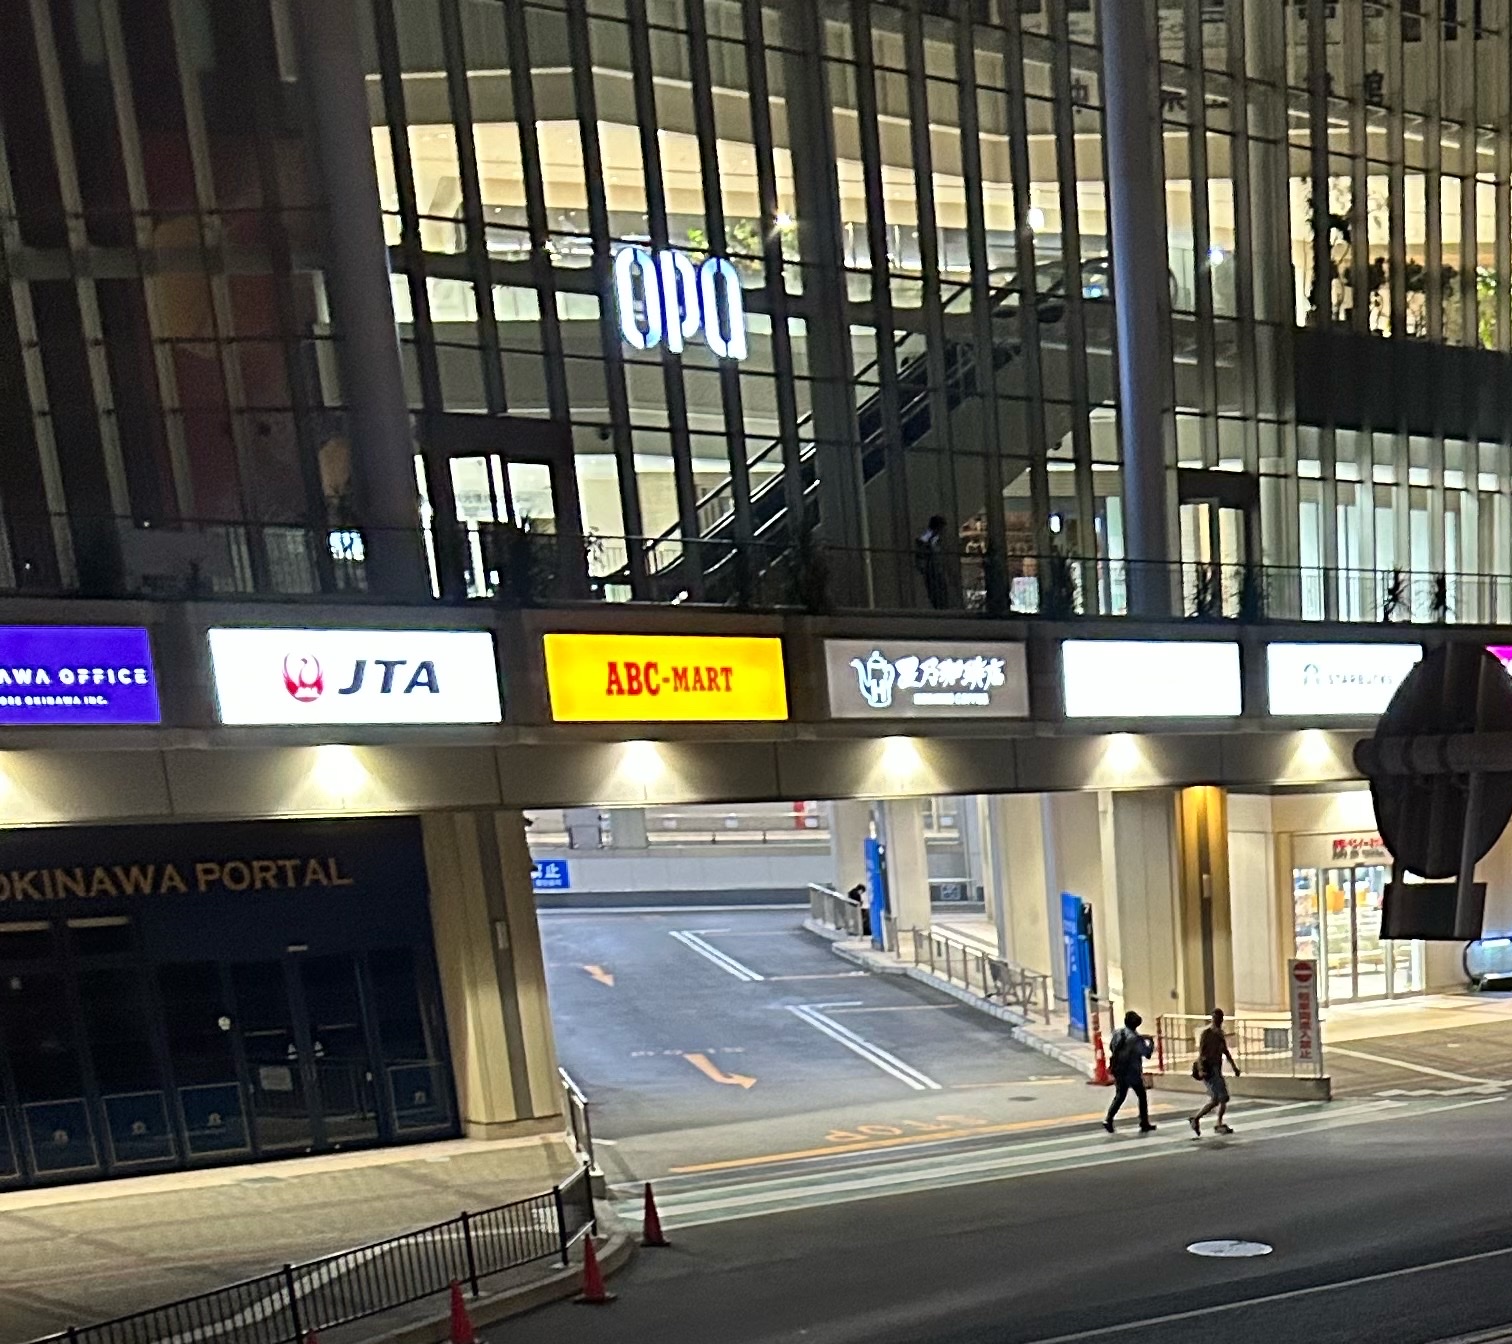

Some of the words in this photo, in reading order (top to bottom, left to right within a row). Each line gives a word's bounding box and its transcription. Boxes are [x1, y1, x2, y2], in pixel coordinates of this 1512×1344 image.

[58, 667, 149, 686] OFFICE
[337, 658, 441, 696] JTA
[605, 660, 734, 697] ABC-MART
[0, 863, 188, 902] KINAWA
[194, 856, 354, 893] PORTAL
